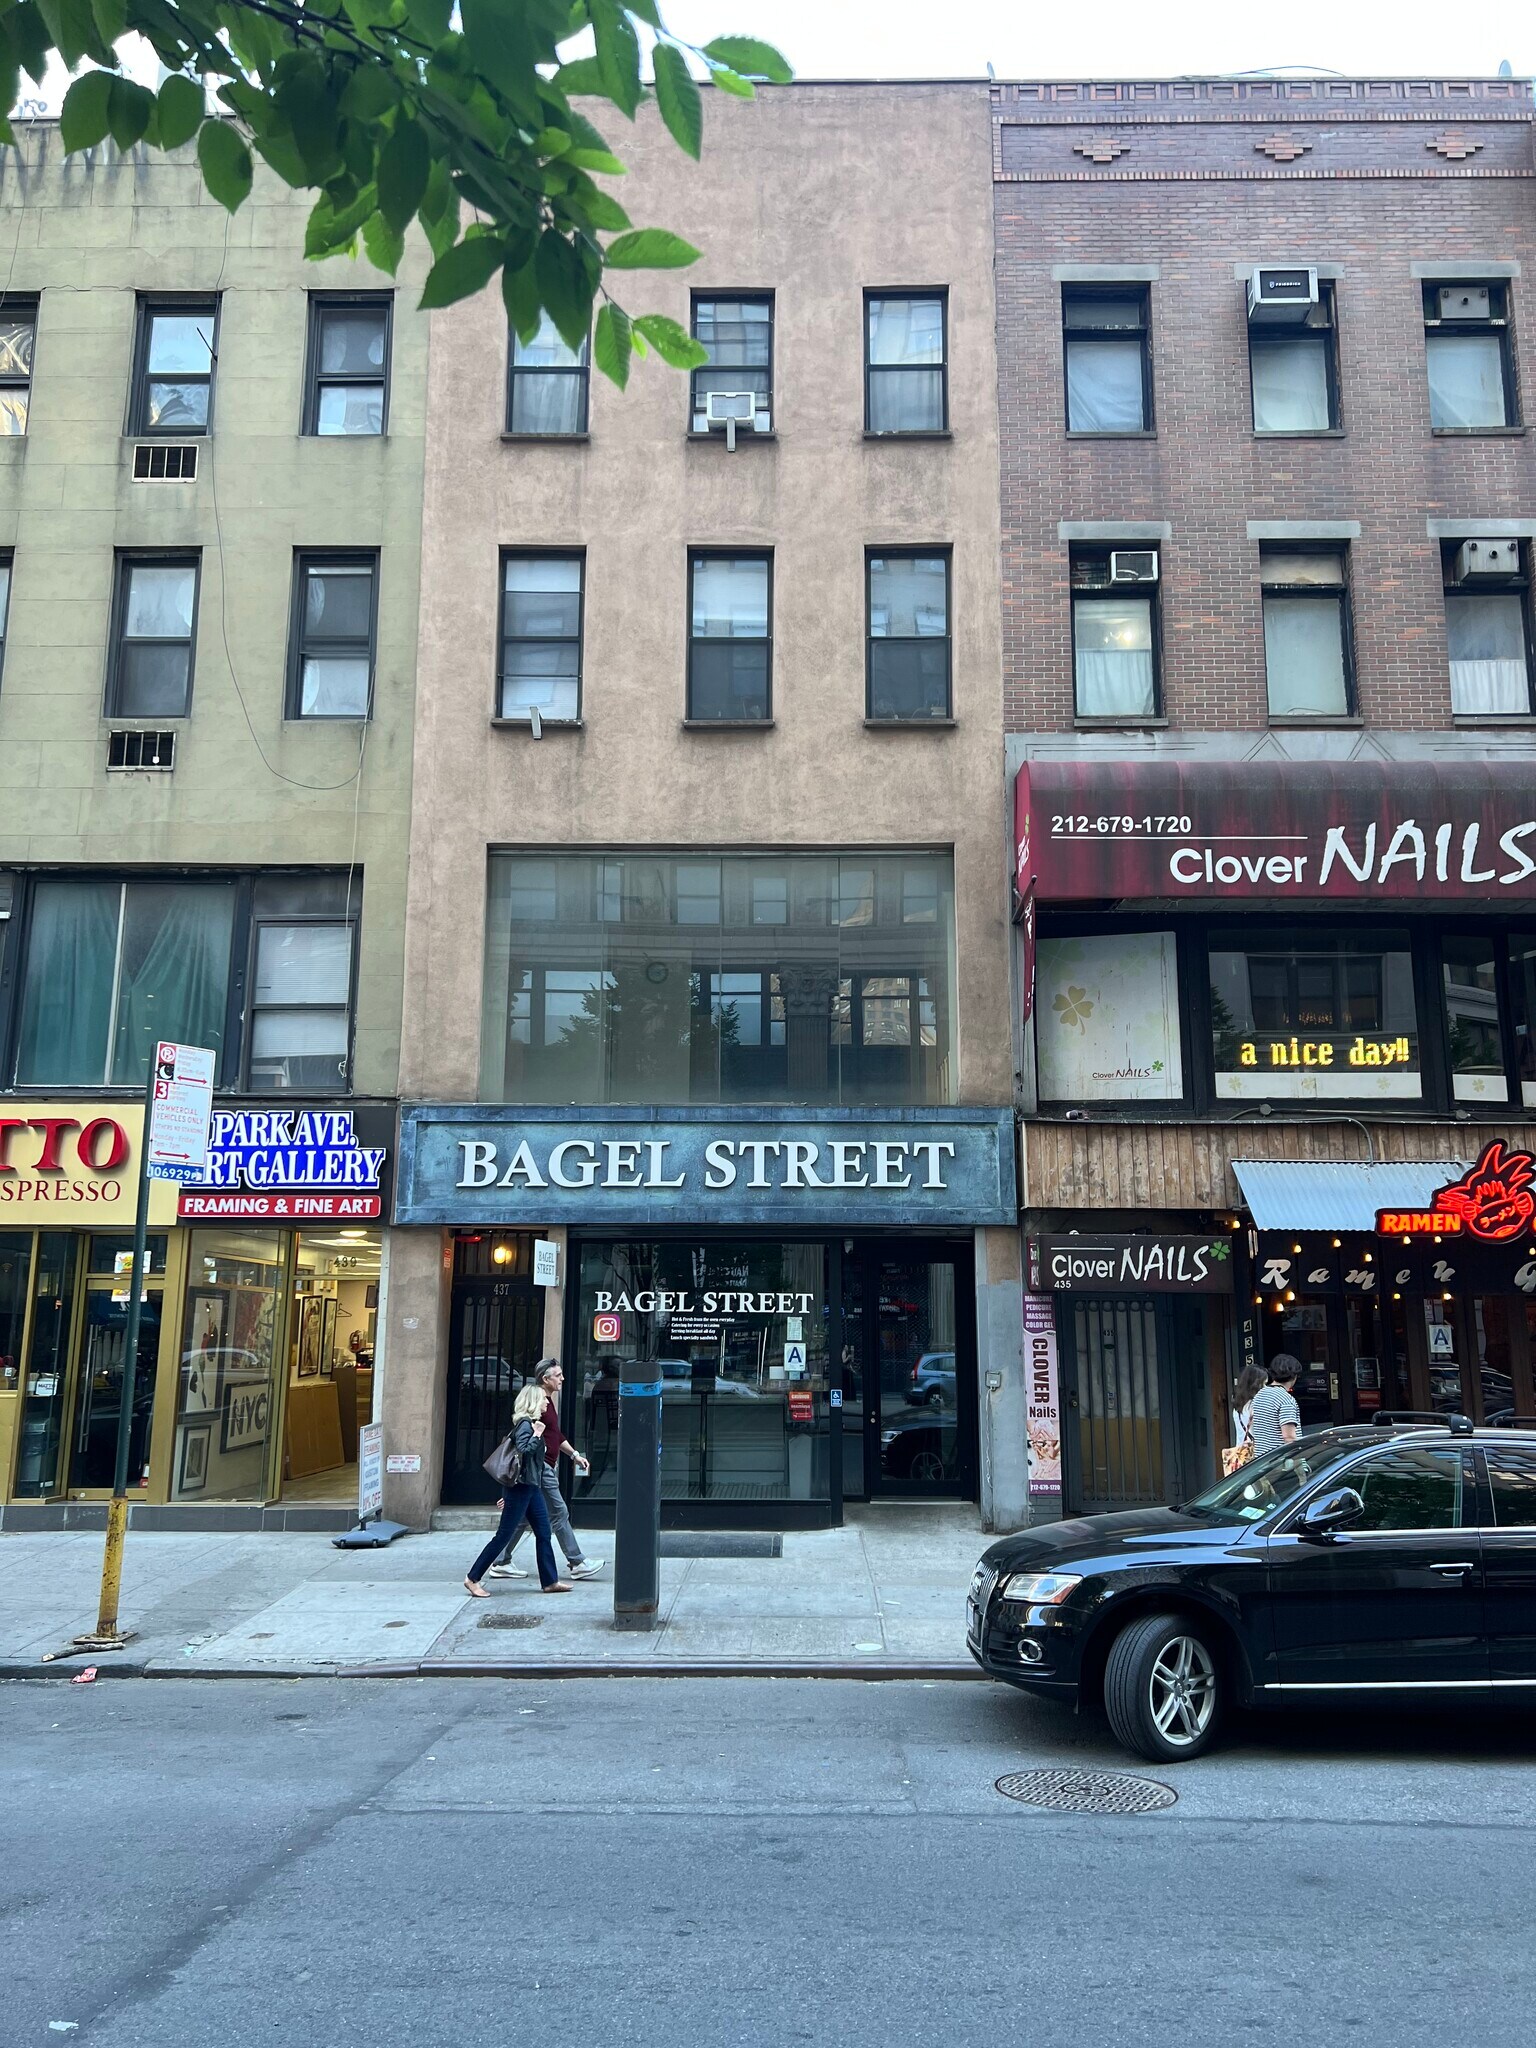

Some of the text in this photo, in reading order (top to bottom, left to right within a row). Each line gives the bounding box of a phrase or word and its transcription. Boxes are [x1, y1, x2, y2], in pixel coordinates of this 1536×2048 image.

[1051, 816, 1192, 833] 212-679-1720
[1169, 819, 1536, 885] Clover NAILS
[1241, 1037, 1410, 1066] a nice day!!
[1116, 1068, 1151, 1078] NAILS
[157, 1082, 167, 1099] 3
[157, 1103, 198, 1116] COMMERCIAL
[157, 1112, 203, 1125] VEHICLES ONLY
[213, 1113, 357, 1147] PARK AVE.
[185, 1150, 383, 1185] RT GALLERY
[456, 1140, 956, 1188] BAGEL STREET
[184, 1198, 373, 1214] FRAMING & FINE ART
[1382, 1213, 1461, 1233] RAMEN
[1479, 1205, 1516, 1229] ラーメン
[333, 1256, 358, 1268] 439
[538, 1251, 554, 1263] BAGEL
[1051, 1254, 1116, 1278] Clover
[1120, 1243, 1210, 1282] NAILS
[537, 1263, 555, 1275] STREET
[493, 1284, 510, 1296] 437
[1054, 1280, 1072, 1289] 435
[594, 1291, 814, 1314] BAGEL STREET
[1026, 1312, 1052, 1320] MASSAGE
[1025, 1321, 1054, 1329] COLOR GEL
[1433, 1328, 1449, 1345] A
[787, 1346, 803, 1363] A
[1032, 1338, 1050, 1403] CLOVER
[229, 1392, 269, 1438] NYC
[1029, 1406, 1057, 1418] Nails
